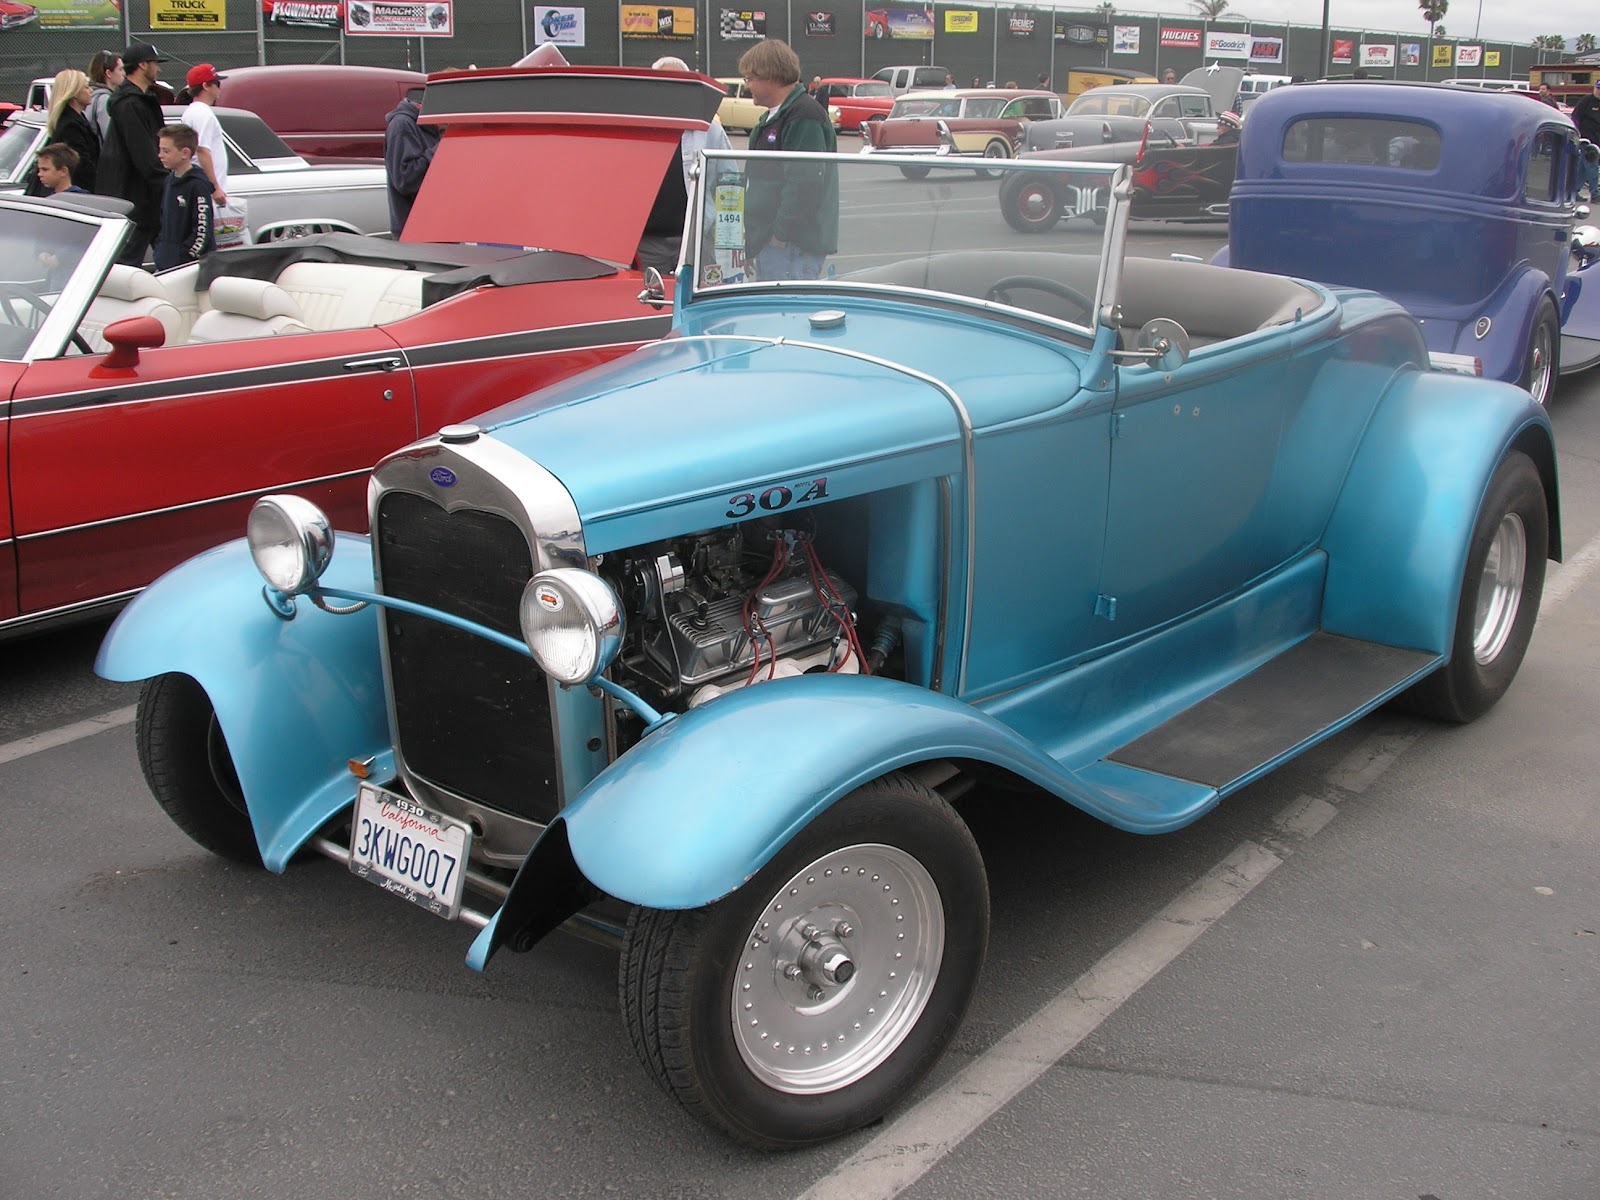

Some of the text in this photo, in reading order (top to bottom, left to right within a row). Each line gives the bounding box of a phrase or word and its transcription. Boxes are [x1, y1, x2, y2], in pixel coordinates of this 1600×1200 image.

[170, 0, 206, 9] TRUCK
[270, 2, 338, 21] FLOWMASTER
[375, 6, 412, 16] MARCH
[554, 20, 577, 31] TIRE
[658, 15, 673, 27] WIX
[1009, 18, 1035, 29] TREMEC
[1161, 30, 1200, 41] HUGHES
[1210, 39, 1246, 49] BFGoodrich
[718, 213, 741, 223] 1494
[432, 469, 453, 483] Ford
[395, 799, 425, 817] 1930
[381, 801, 445, 842] California
[358, 818, 456, 896] 3KWG007
